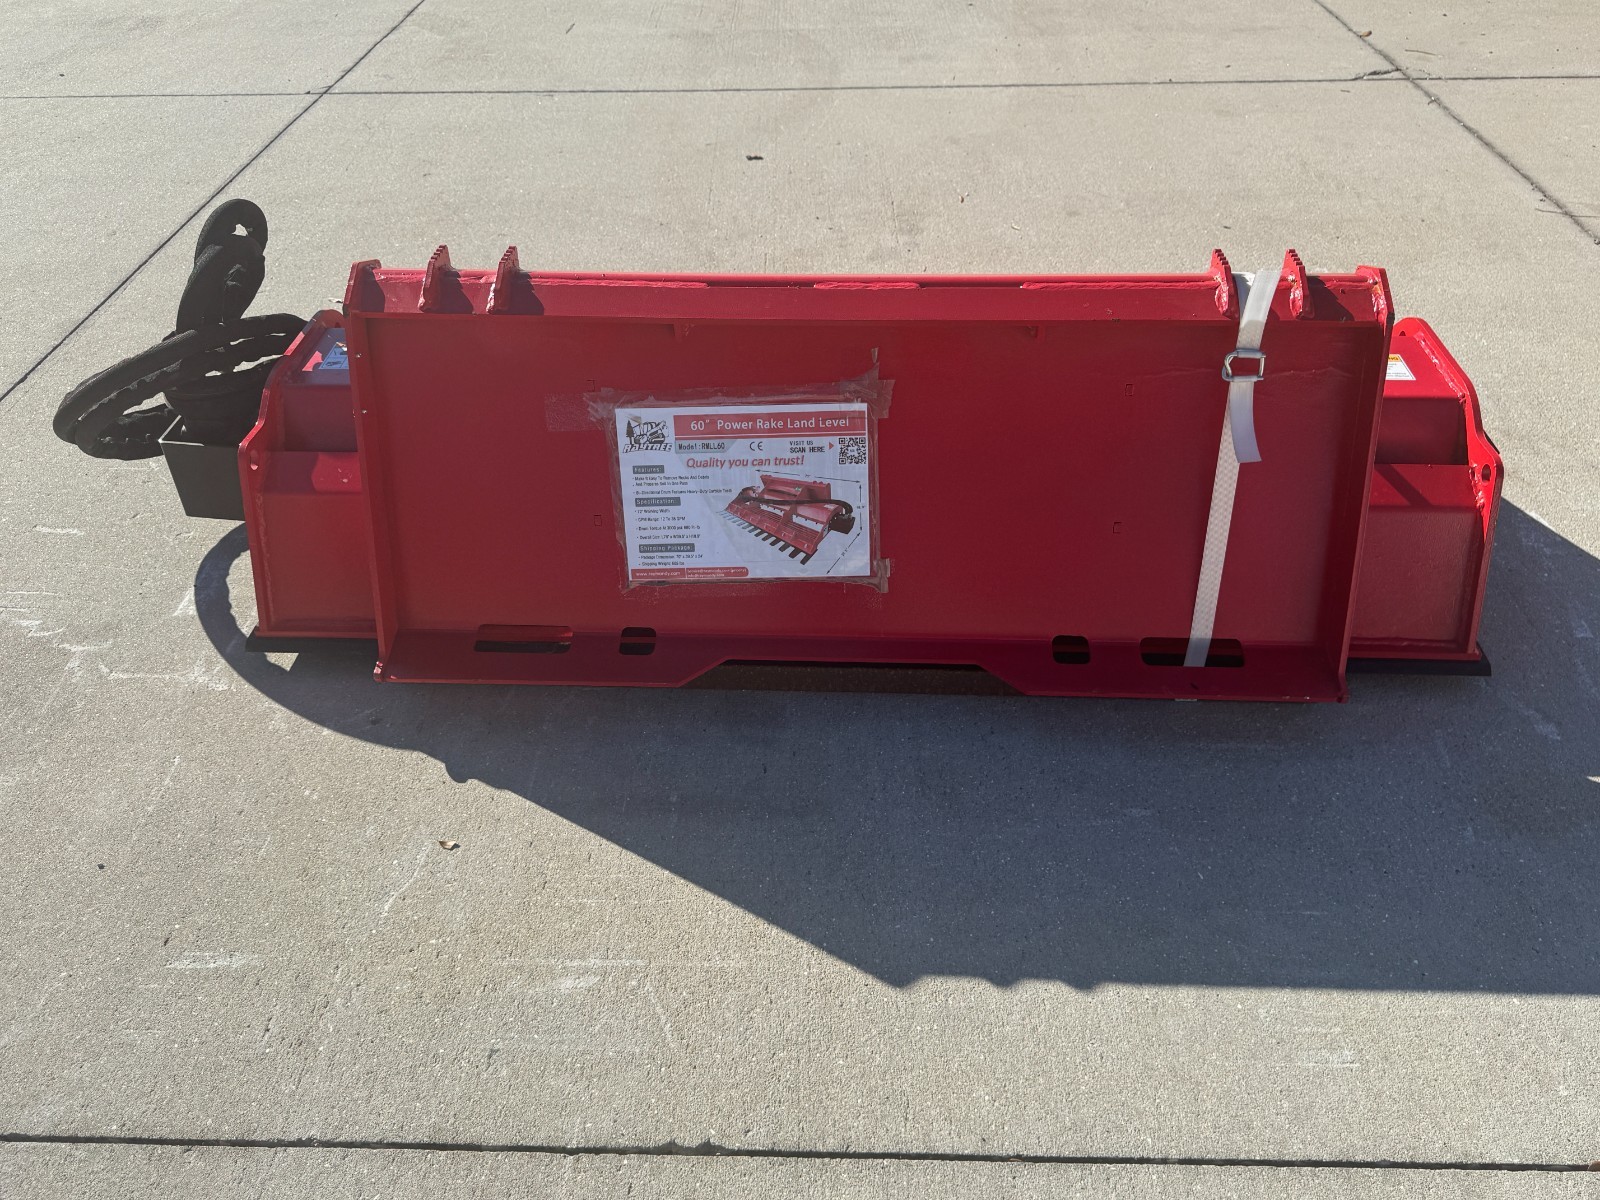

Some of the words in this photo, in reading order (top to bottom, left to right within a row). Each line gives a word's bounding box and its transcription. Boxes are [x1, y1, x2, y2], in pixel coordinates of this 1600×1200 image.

[690, 420, 710, 430] 60"
[717, 419, 753, 430] Power
[756, 418, 784, 429] Rake
[788, 418, 815, 428] Land
[819, 416, 849, 427] Level
[622, 442, 672, 453] RAYTREE
[686, 457, 726, 469] Quality
[728, 459, 748, 469] you
[774, 455, 804, 466] trust!
